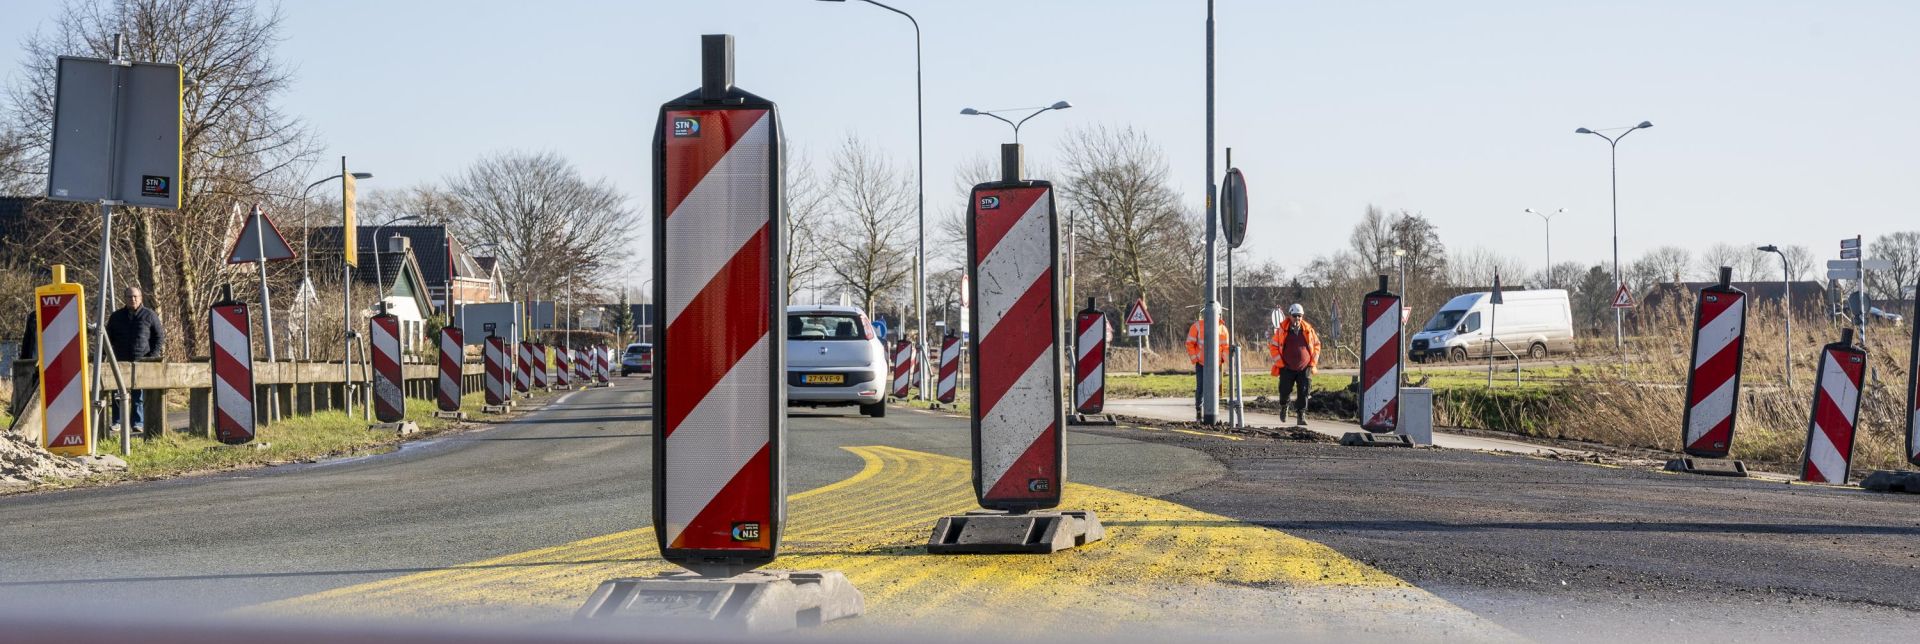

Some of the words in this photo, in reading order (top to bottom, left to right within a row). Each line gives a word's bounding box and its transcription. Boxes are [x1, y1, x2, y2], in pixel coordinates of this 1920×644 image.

[675, 121, 690, 129] STN
[145, 178, 159, 186] STN
[42, 296, 61, 306] VTV
[63, 436, 83, 445] VTV
[742, 530, 759, 538] STN
